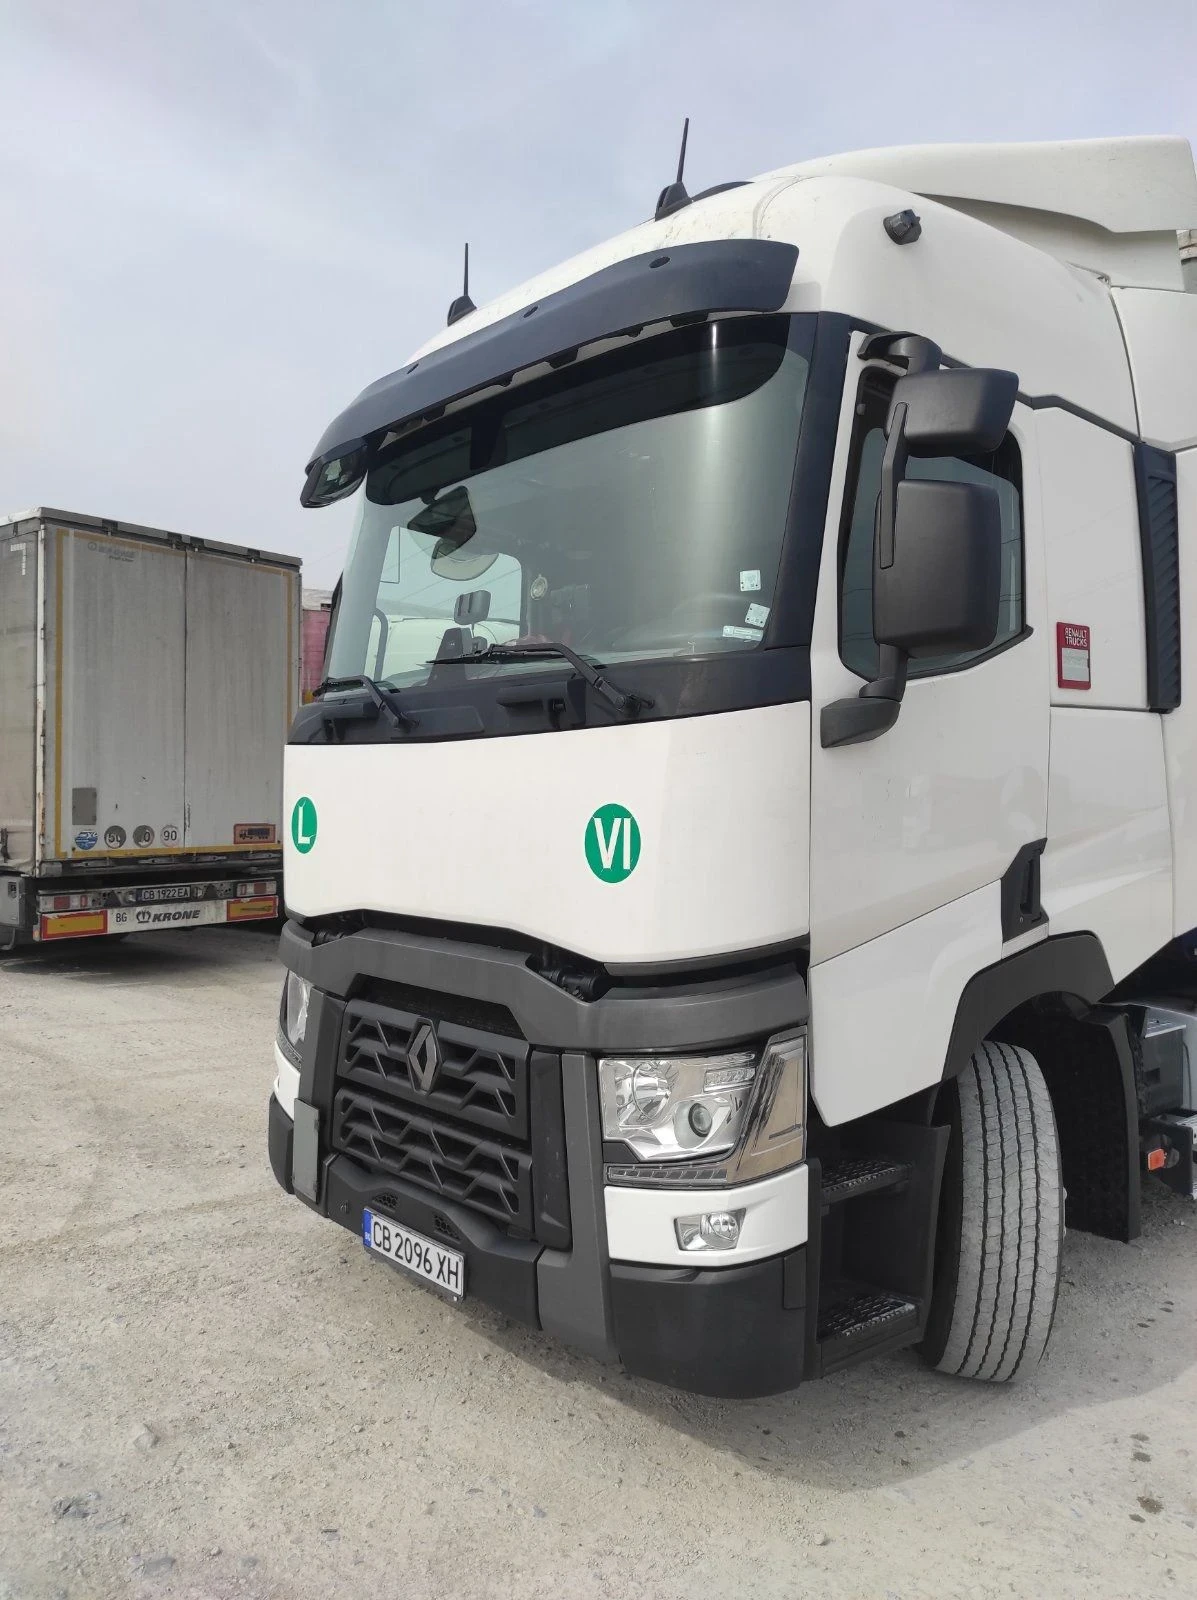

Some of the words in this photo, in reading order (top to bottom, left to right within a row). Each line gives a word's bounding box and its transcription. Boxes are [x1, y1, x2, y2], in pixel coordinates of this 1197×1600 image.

[1064, 627, 1088, 639] RENAULT
[1065, 636, 1088, 648] TRUCKS
[297, 806, 310, 844] L
[163, 830, 177, 841] 90
[593, 817, 631, 869] VI
[143, 890, 155, 900] CB
[157, 889, 177, 899] 1922
[178, 887, 189, 898] EA
[115, 912, 128, 923] BG
[152, 909, 201, 923] KRONE
[373, 1221, 392, 1253] CB
[394, 1232, 433, 1275] 2096
[436, 1251, 459, 1289] XH
